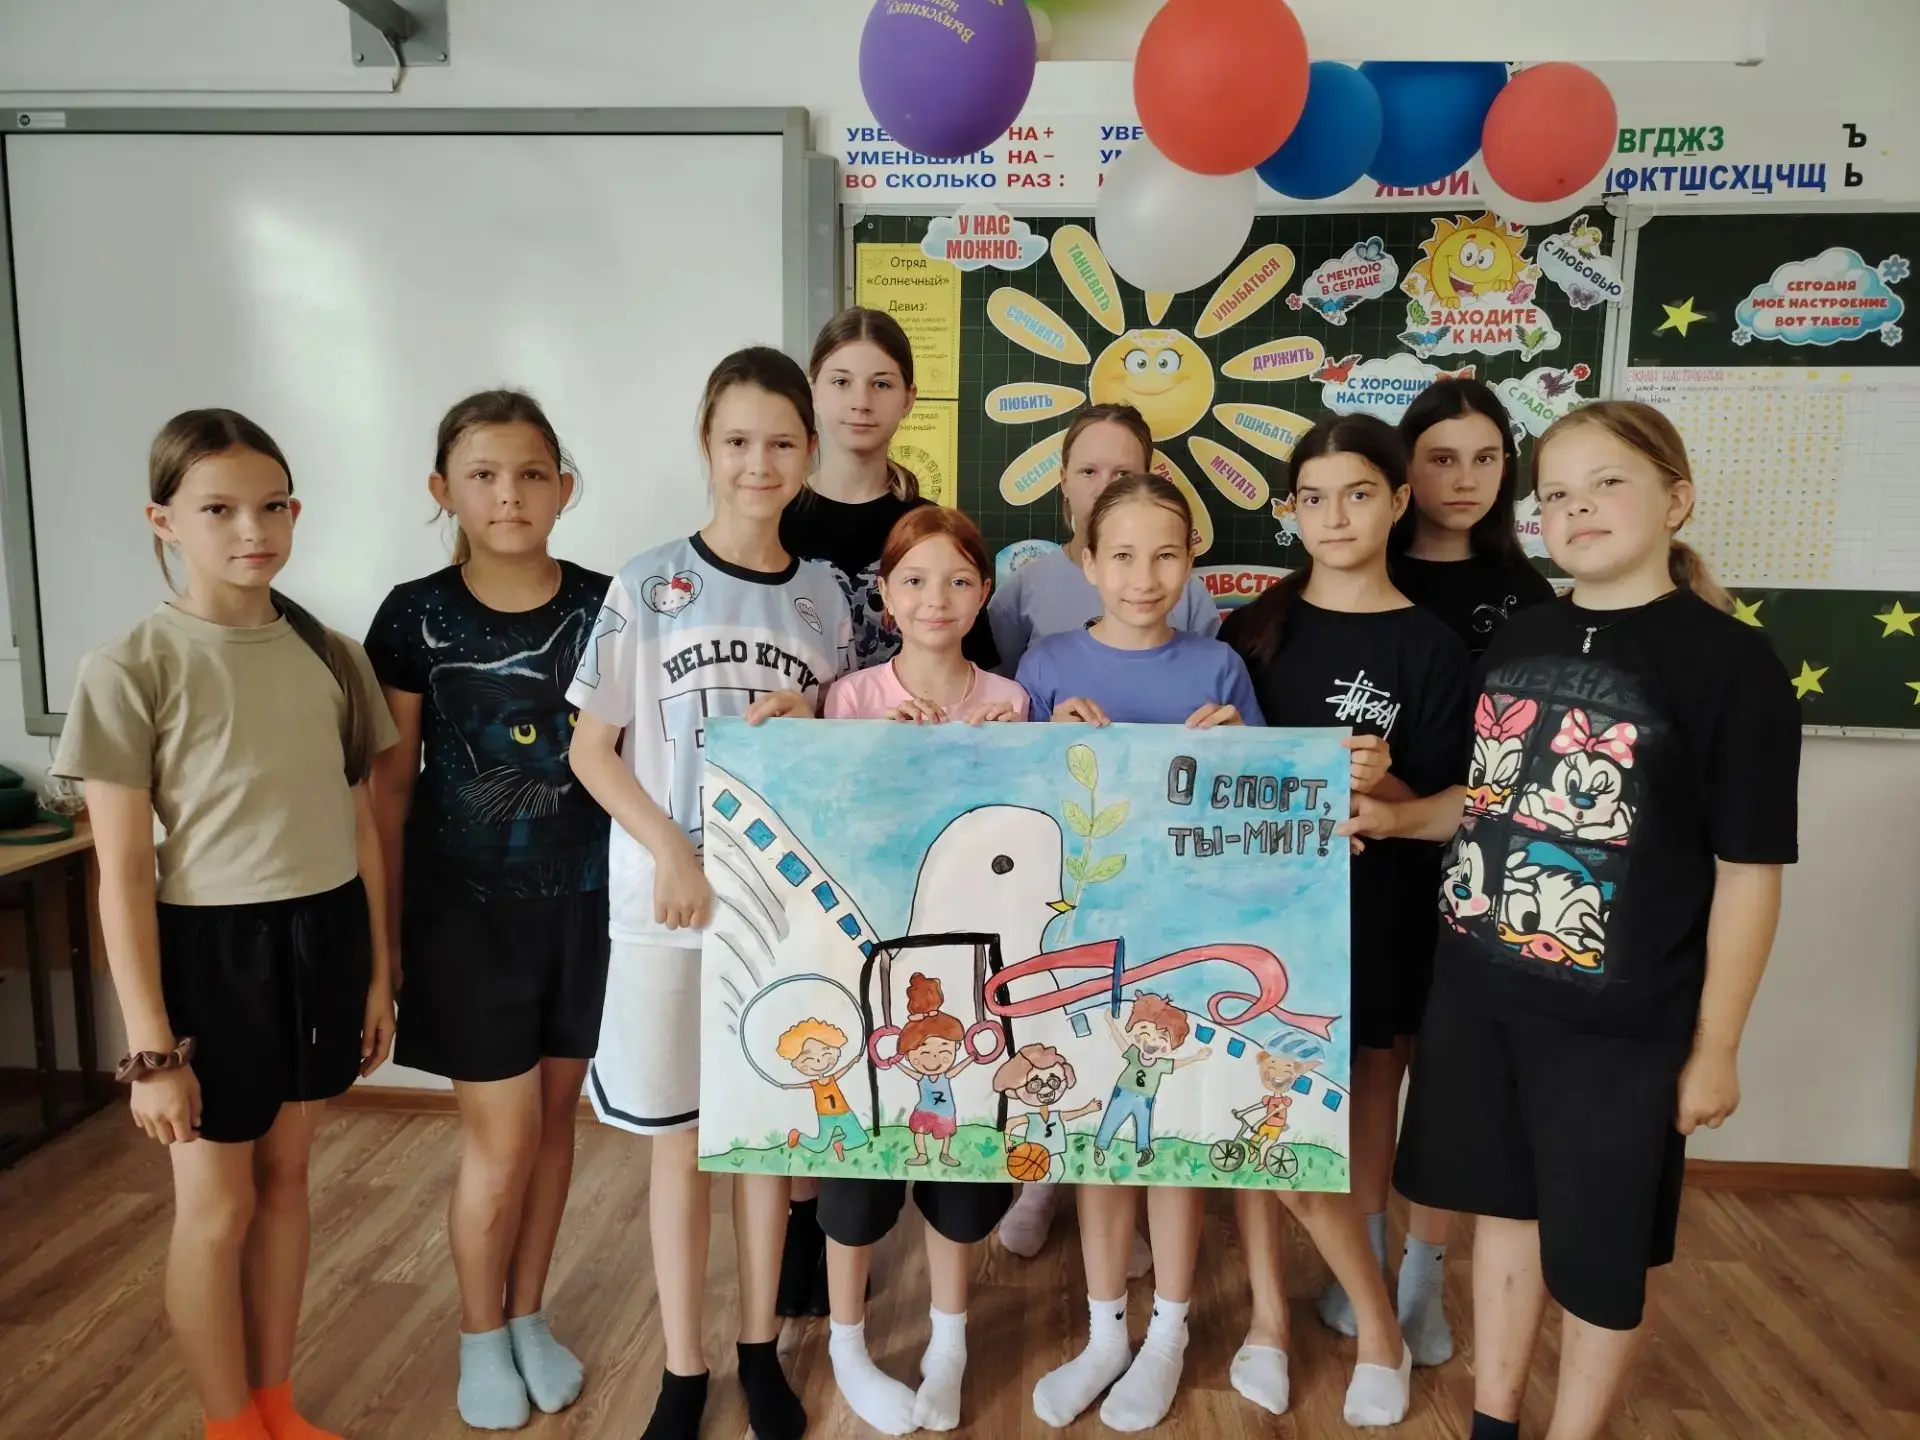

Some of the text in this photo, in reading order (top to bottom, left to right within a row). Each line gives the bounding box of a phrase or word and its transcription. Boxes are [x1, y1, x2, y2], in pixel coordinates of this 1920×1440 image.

[847, 127, 893, 141] УВЕ
[1008, 127, 1038, 141] НА
[1842, 123, 1867, 148] Ъ
[1008, 150, 1038, 164] НА
[846, 174, 877, 189] ВО
[885, 173, 997, 188] СКОЛЬКО
[1007, 173, 1051, 188] РАЗ
[1844, 163, 1863, 187] Ь
[959, 215, 1010, 235] У НАС
[946, 239, 1023, 260] МОЖНО:
[890, 256, 927, 270] Отряд
[1543, 241, 1621, 297] С ЛЮБОВЬЮ
[867, 275, 950, 286] «Солнечный»
[1067, 243, 1112, 312] ТАНЦЕВАТЬ
[1316, 262, 1382, 283] С МЕЧТОЮ
[1212, 257, 1281, 322] УЛЫБАТЬСЯ
[1321, 274, 1381, 295] В СЕРДЦЕ
[1787, 280, 1857, 292] СЕГОДНЯ
[888, 300, 928, 313] Девиз:
[1752, 295, 1888, 309] МОЁ НАСТРОЕНИЕ
[1431, 308, 1537, 326] ЗАХОДИТЕ
[1775, 316, 1861, 327] ВОТ ТАКОЕ
[1453, 327, 1512, 344] К НАМ
[1252, 348, 1315, 372] ДРУЖИТЬ
[1347, 378, 1357, 389] С
[1508, 386, 1518, 397] С
[998, 394, 1053, 411] ЛЮБИТЬ
[1336, 391, 1416, 405] НАСТРОЕН
[1209, 455, 1257, 501] МЕЧТАТЬ
[663, 640, 748, 684] HELLO
[1168, 755, 1332, 815] О СПОРТ,
